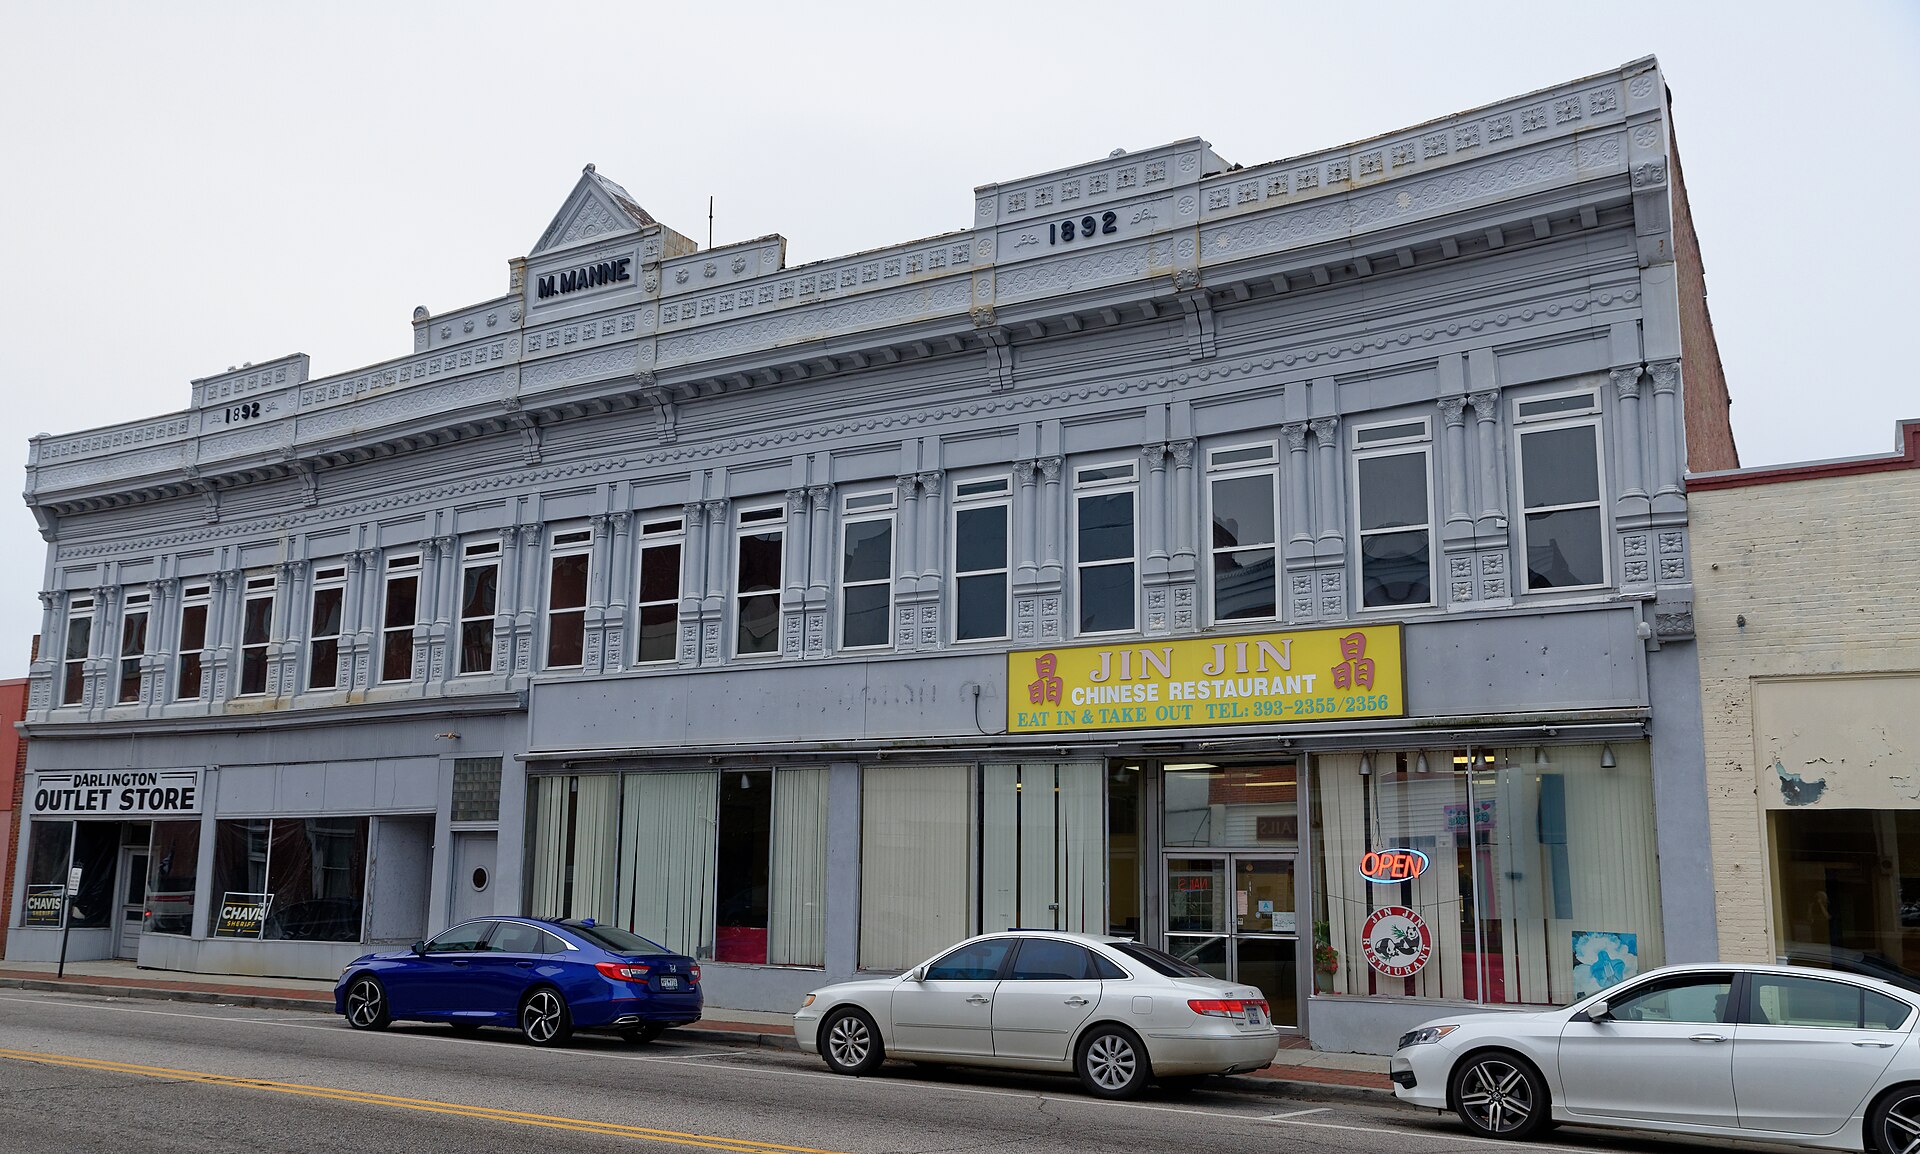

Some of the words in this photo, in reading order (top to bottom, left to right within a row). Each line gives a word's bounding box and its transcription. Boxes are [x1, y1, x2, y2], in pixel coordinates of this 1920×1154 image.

[1049, 211, 1117, 245] 1892
[225, 402, 260, 424] 1892
[1089, 647, 1173, 682] JIN
[1202, 639, 1293, 676] JIN
[1331, 631, 1375, 691] 晶
[1028, 652, 1064, 707] 晶
[1071, 683, 1159, 706] CHINESE
[1169, 673, 1317, 700] RESTAURANT
[1017, 711, 1049, 727] EAT
[1056, 709, 1077, 726] IN
[1081, 709, 1094, 724] &
[1098, 706, 1147, 724] TAKE
[1155, 704, 1193, 721] OUT
[1205, 702, 1249, 719] TEL:
[1253, 694, 1388, 717] 393-2355/2356
[73, 772, 158, 788] DARLINGTON
[35, 788, 112, 811] OUTLET
[119, 787, 195, 811] STORE
[1361, 852, 1422, 879] OPEN
[28, 897, 61, 910] CHAVIS
[222, 906, 264, 920] CHAVIS
[1371, 907, 1392, 924] JIN
[1402, 910, 1425, 928] JIN
[1363, 938, 1430, 976] RESTAURANT
